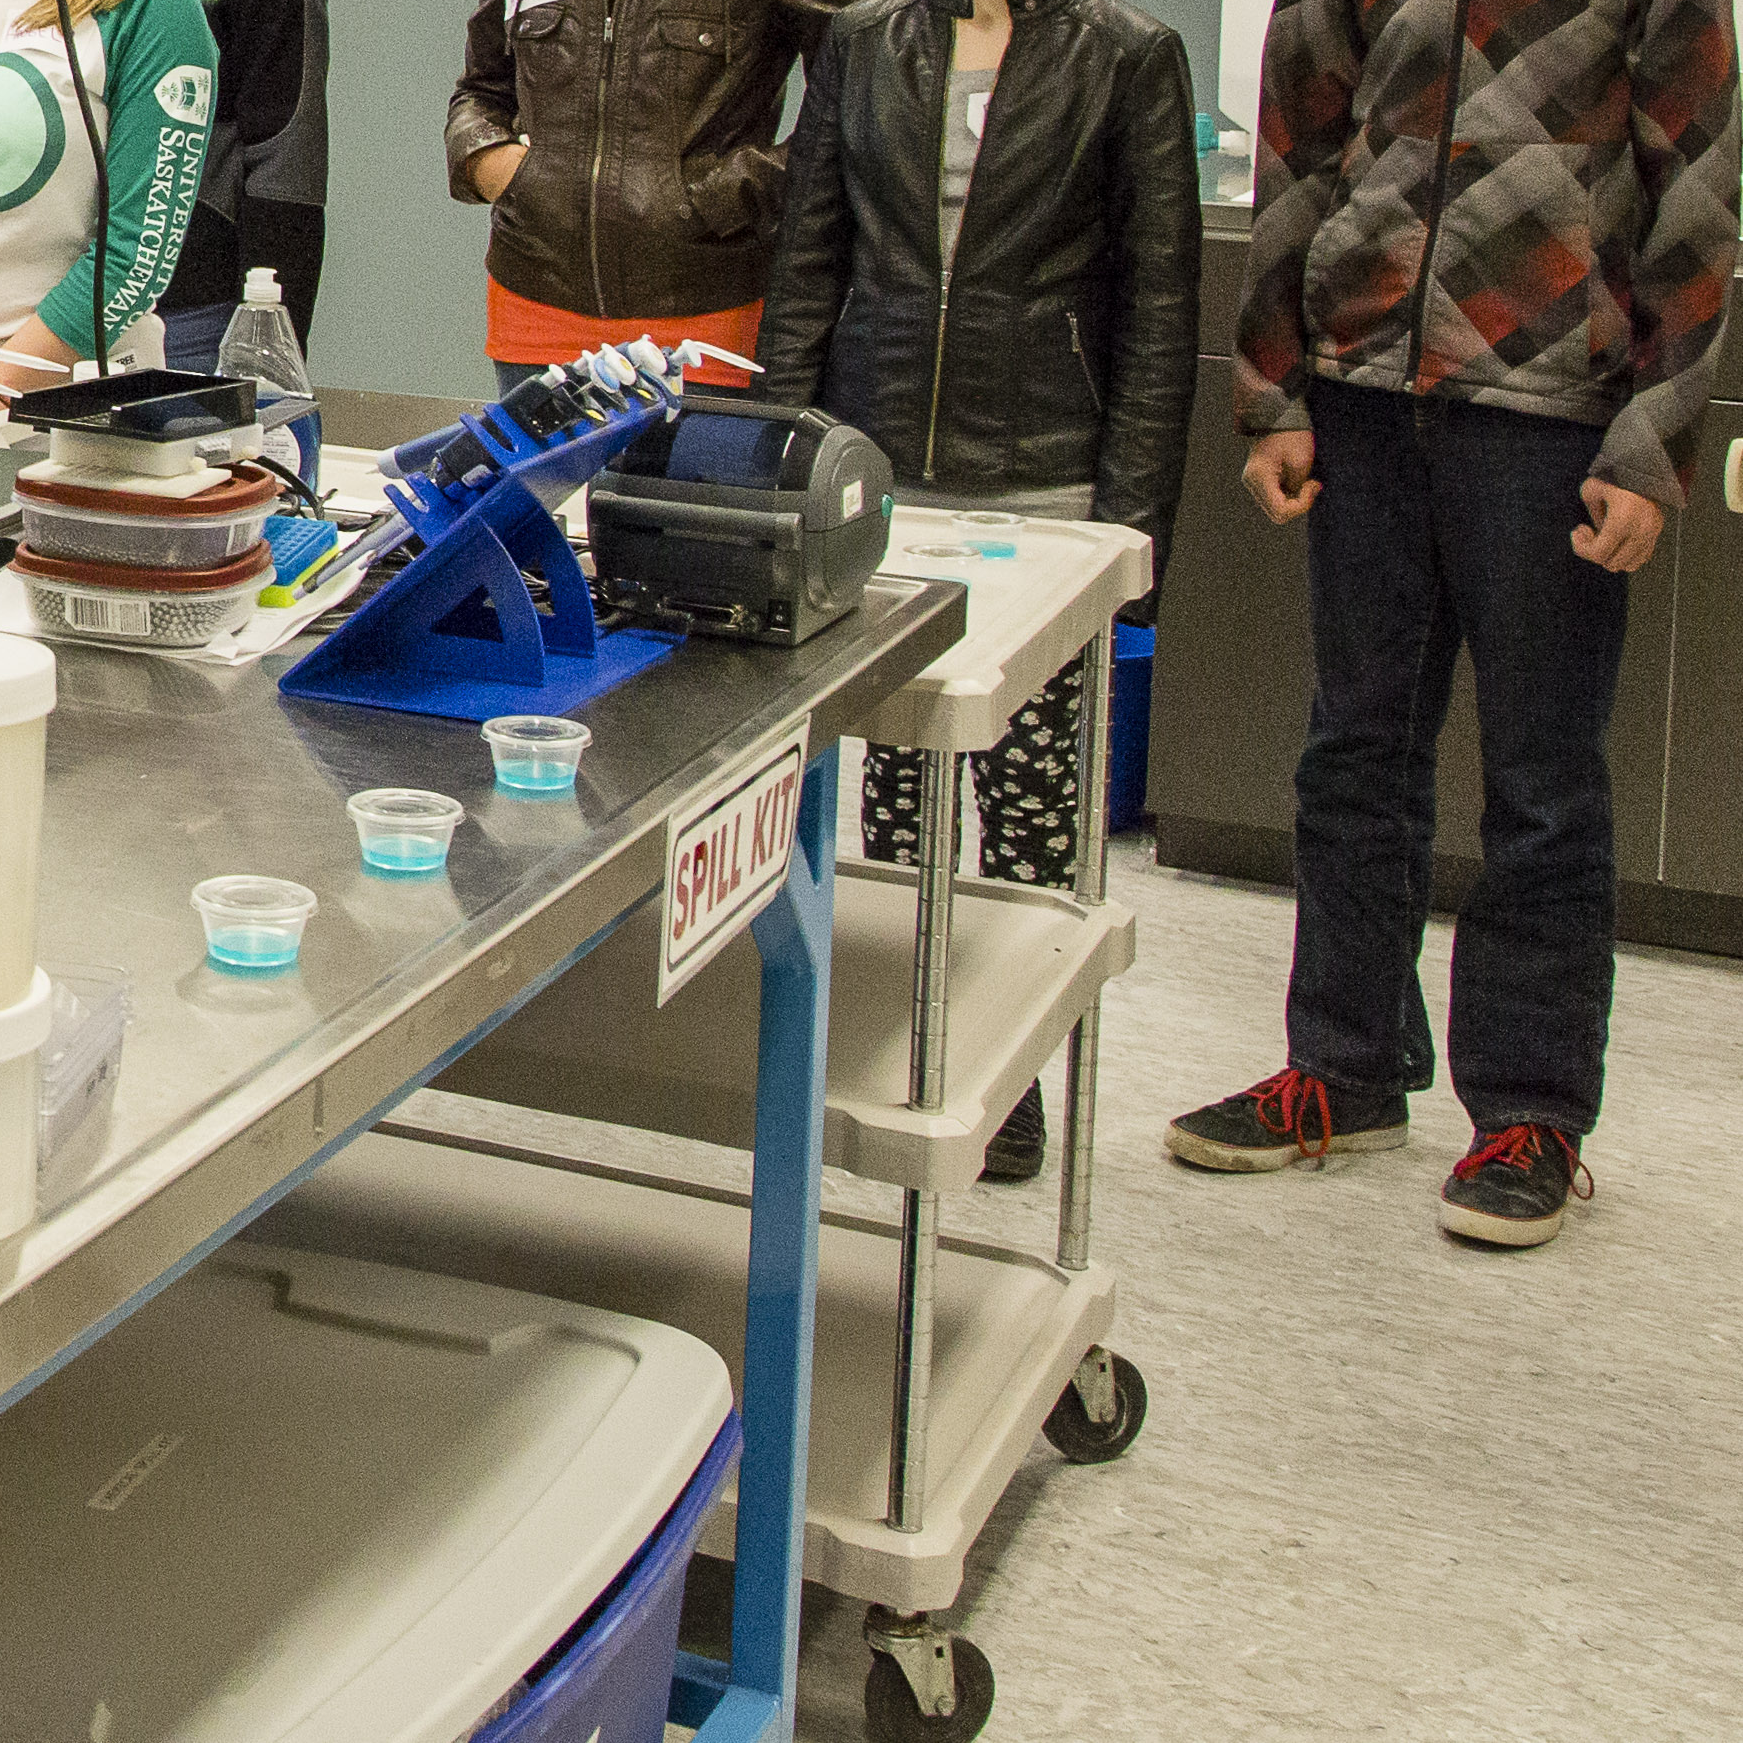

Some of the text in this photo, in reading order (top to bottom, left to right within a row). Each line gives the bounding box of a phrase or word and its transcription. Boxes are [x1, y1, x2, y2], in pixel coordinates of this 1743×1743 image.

[104, 126, 186, 333] SASKATCHEWAN
[147, 132, 206, 306] UNIVERSITY
[116, 354, 136, 366] REE
[674, 771, 796, 941] SPILL KIT
